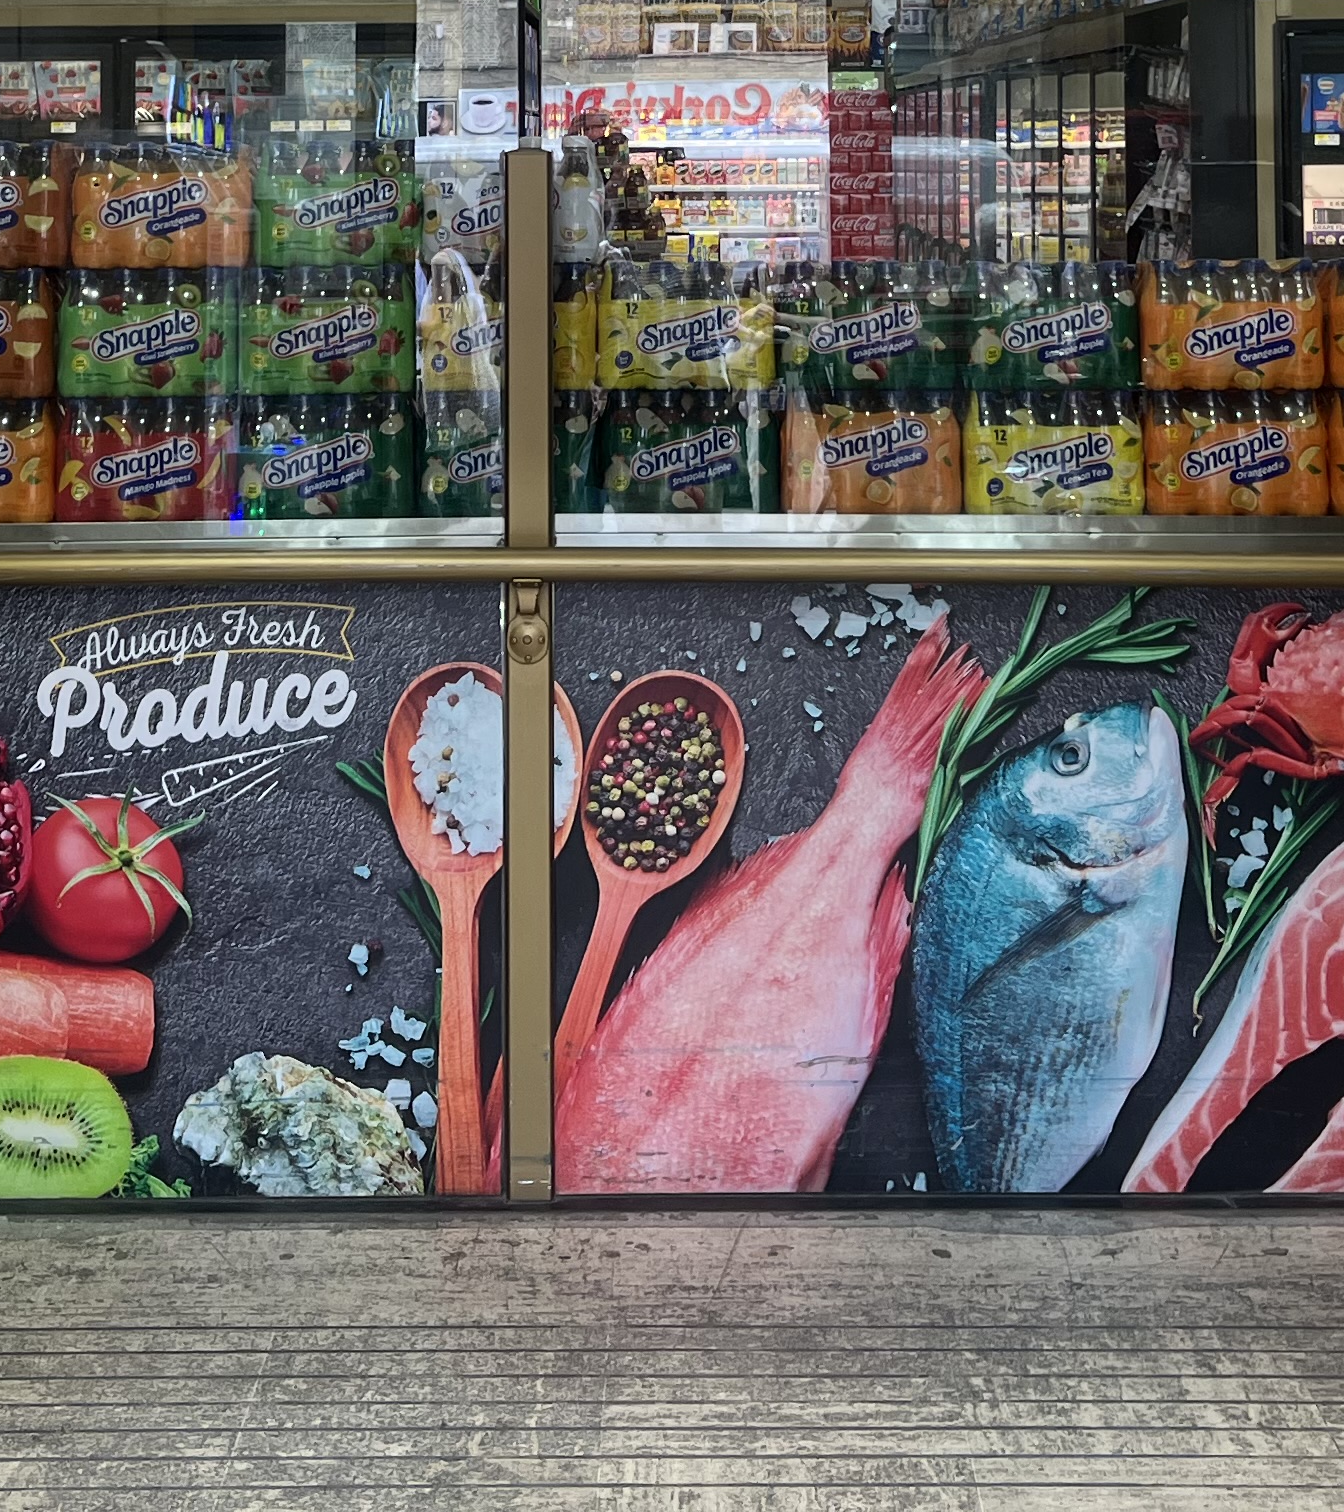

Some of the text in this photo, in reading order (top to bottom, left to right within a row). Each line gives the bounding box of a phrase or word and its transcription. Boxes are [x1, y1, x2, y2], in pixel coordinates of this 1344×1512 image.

[102, 179, 203, 224] Snapple
[440, 182, 455, 195] 12
[297, 179, 395, 225] Snapple
[151, 211, 200, 232] Orangeade
[1312, 232, 1336, 245] ice
[438, 306, 453, 320] 12
[625, 303, 639, 315] 12
[94, 312, 195, 357] Snapple
[273, 306, 373, 355] Snapple
[814, 304, 915, 350] Snapple
[1005, 304, 1106, 351] Snapple
[1188, 310, 1291, 357] Snapple
[888, 338, 914, 353] Apple
[1078, 337, 1105, 353] Apple
[1240, 343, 1290, 362] Orangeade
[619, 428, 632, 439] 12
[821, 420, 924, 465] Snapple
[994, 429, 1008, 441] 12
[93, 438, 195, 484] Snapple
[267, 435, 368, 482] Snapple
[634, 429, 735, 477] Snapple
[872, 451, 923, 470] Orangeade
[1184, 429, 1285, 475] Snapple
[707, 463, 733, 479] Apple
[1063, 466, 1108, 486] Lemon Tea
[1236, 461, 1286, 480] Orangeade
[125, 472, 192, 498] Mango Madness
[76, 606, 326, 671] Always Fresh
[36, 649, 358, 758] Produce
